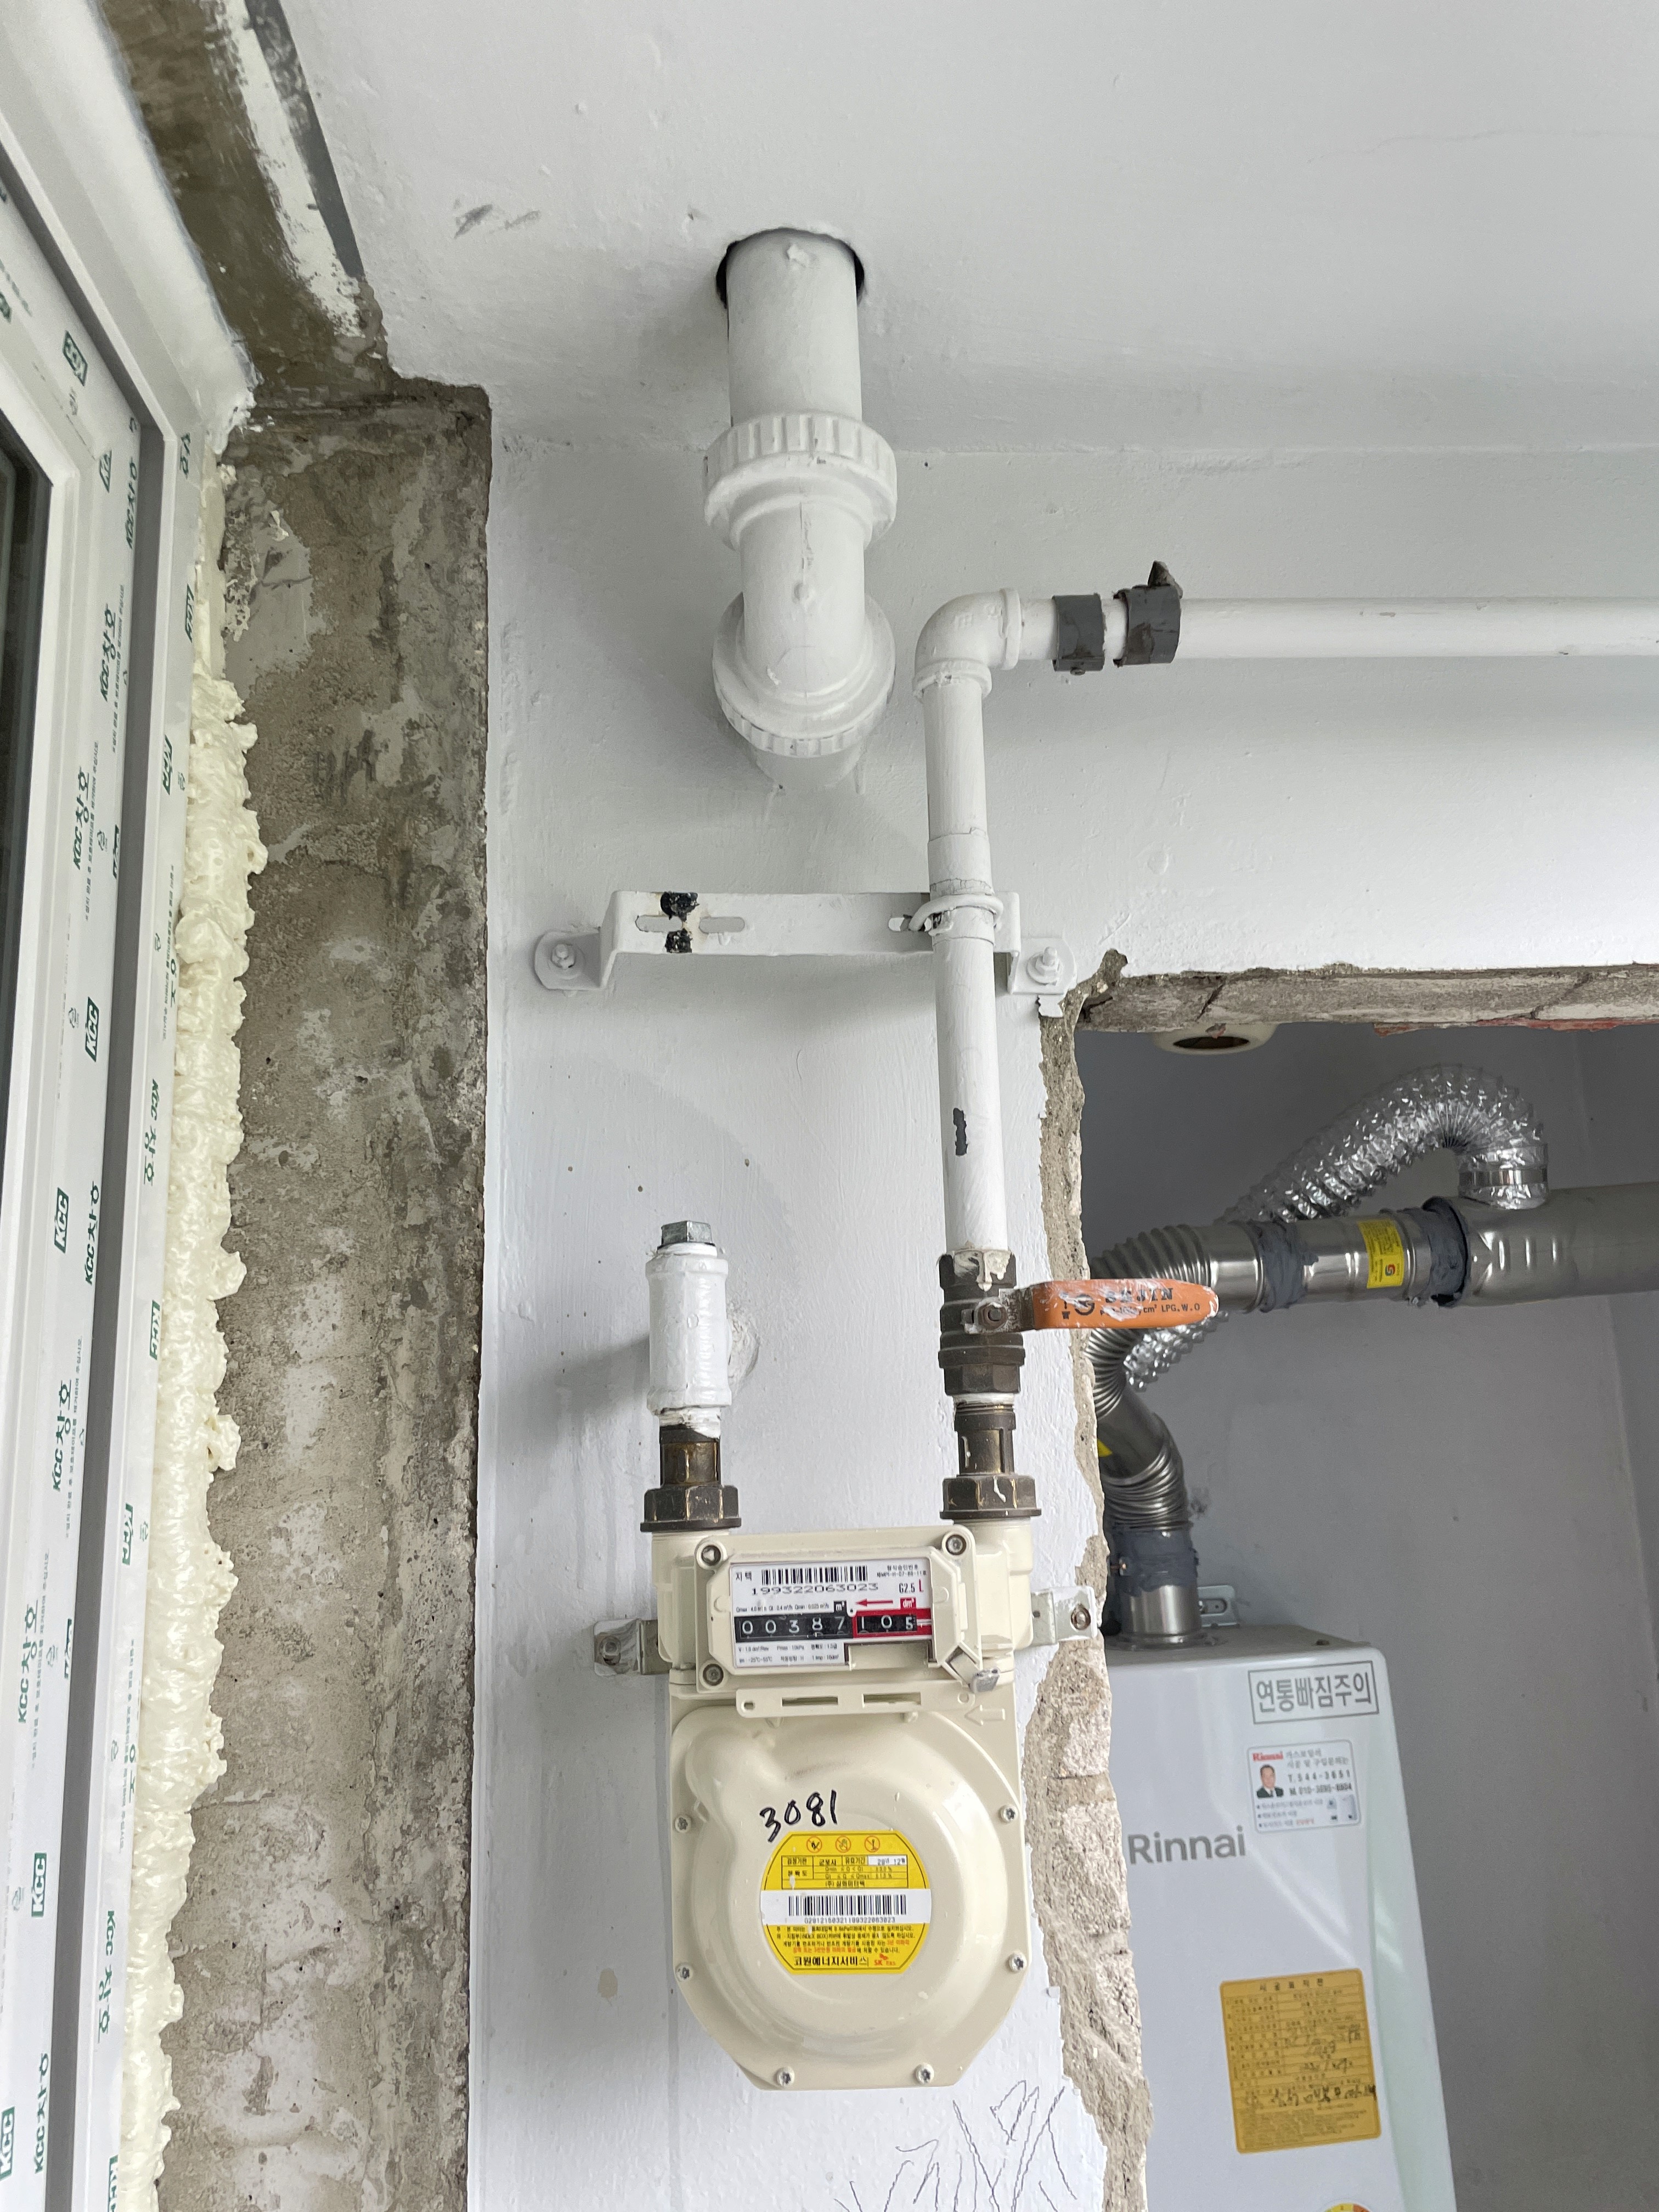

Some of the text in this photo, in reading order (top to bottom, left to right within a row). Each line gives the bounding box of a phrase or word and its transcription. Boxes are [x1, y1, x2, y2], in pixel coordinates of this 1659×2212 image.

[99, 659, 109, 702] KCC
[73, 826, 83, 870] KCC
[86, 1003, 98, 1051] KCC
[151, 1079, 160, 1121] KCC
[54, 1194, 68, 1247] KCC
[84, 1244, 94, 1285] KCC
[150, 1308, 160, 1357] KCC
[52, 1448, 63, 1491] KCC
[752, 1582, 879, 1595] 199322063023
[899, 1582, 915, 1594] G2.5
[18, 1678, 28, 1723] KCC
[1256, 1671, 1372, 1713] 연통빠짐주의
[759, 1789, 838, 1842] 3081
[1127, 1825, 1246, 1865] Rinnai
[32, 1858, 46, 1912] KCC
[106, 1910, 115, 1956] KCC
[794, 1955, 867, 1966] 코원에너지서비스
[0, 2114, 14, 2173] KCC
[34, 2126, 45, 2174] KCC
